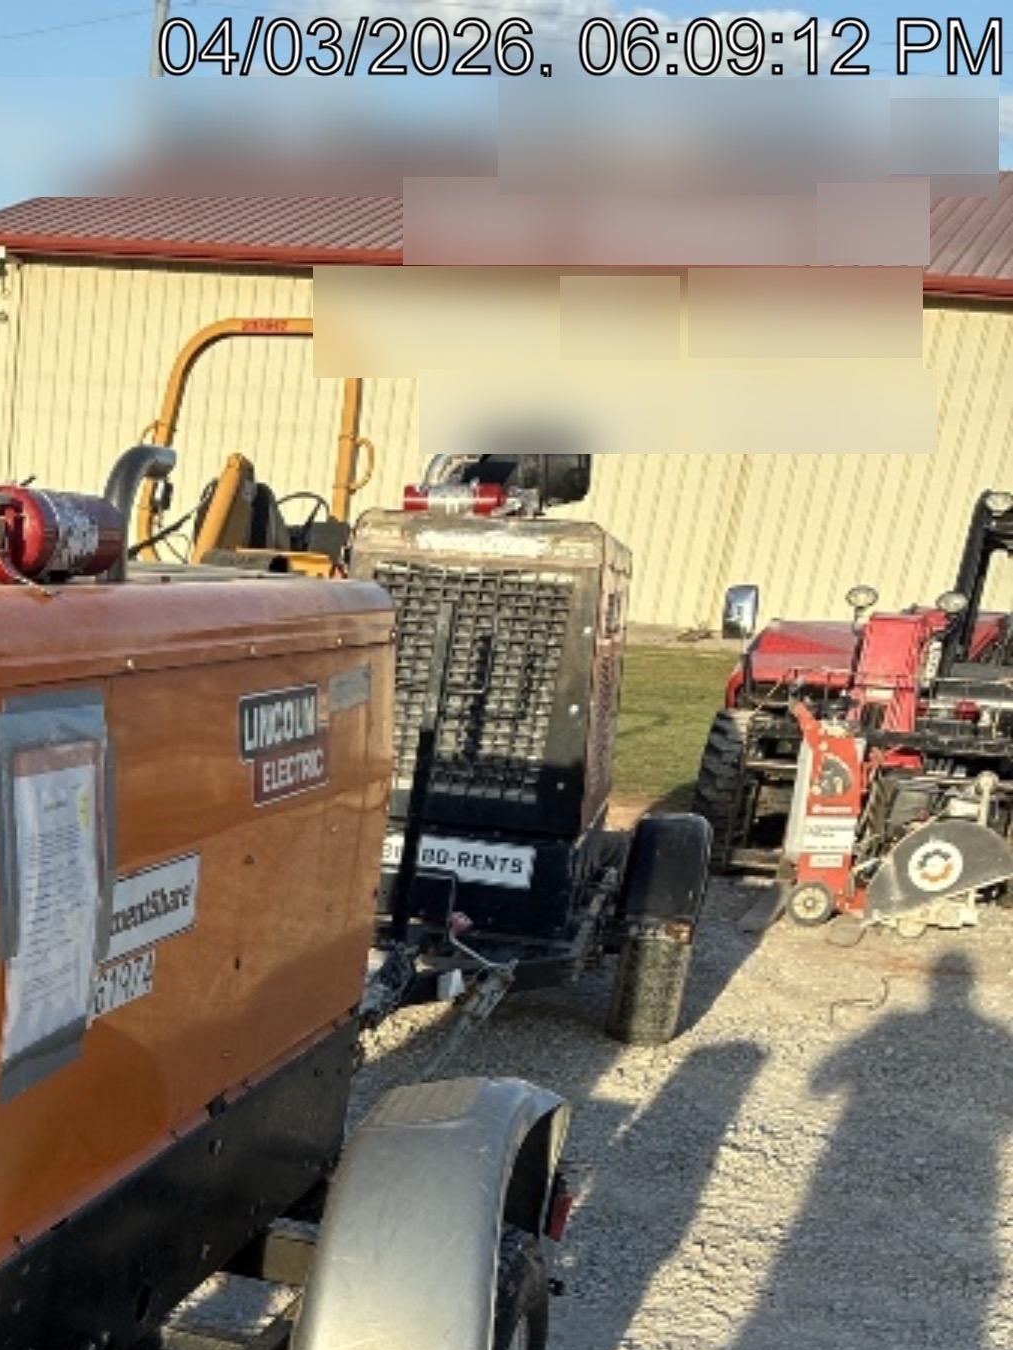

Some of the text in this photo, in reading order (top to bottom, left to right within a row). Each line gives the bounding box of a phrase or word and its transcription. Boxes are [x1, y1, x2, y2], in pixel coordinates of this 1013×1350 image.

[244, 694, 316, 751] LINCOLN
[262, 748, 325, 793] ELECTRIC
[421, 847, 524, 874] 80-RENTS
